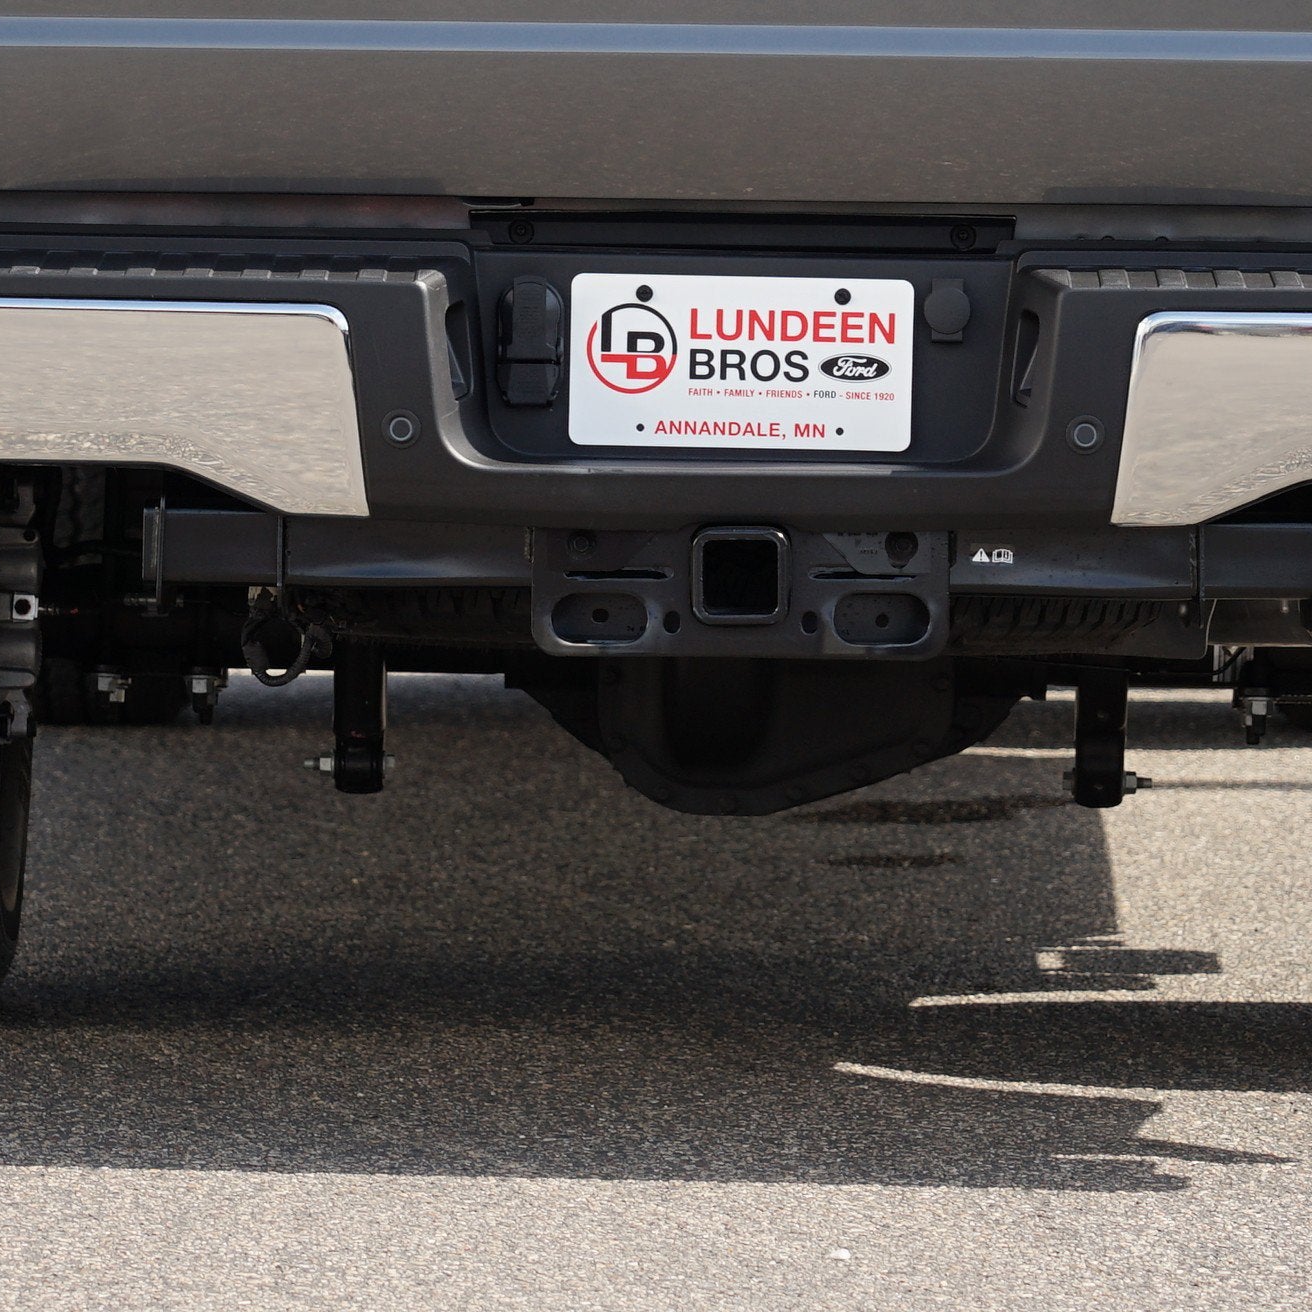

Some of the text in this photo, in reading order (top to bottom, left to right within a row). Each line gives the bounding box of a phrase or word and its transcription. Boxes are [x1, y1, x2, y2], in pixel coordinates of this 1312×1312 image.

[689, 307, 896, 345] LUNDEEN
[688, 348, 879, 383] BROS Ford
[688, 387, 895, 401] FAITH FAMILY FRIENDS FORD SINCE 1920
[654, 419, 825, 440] ANNANDALE, MN
